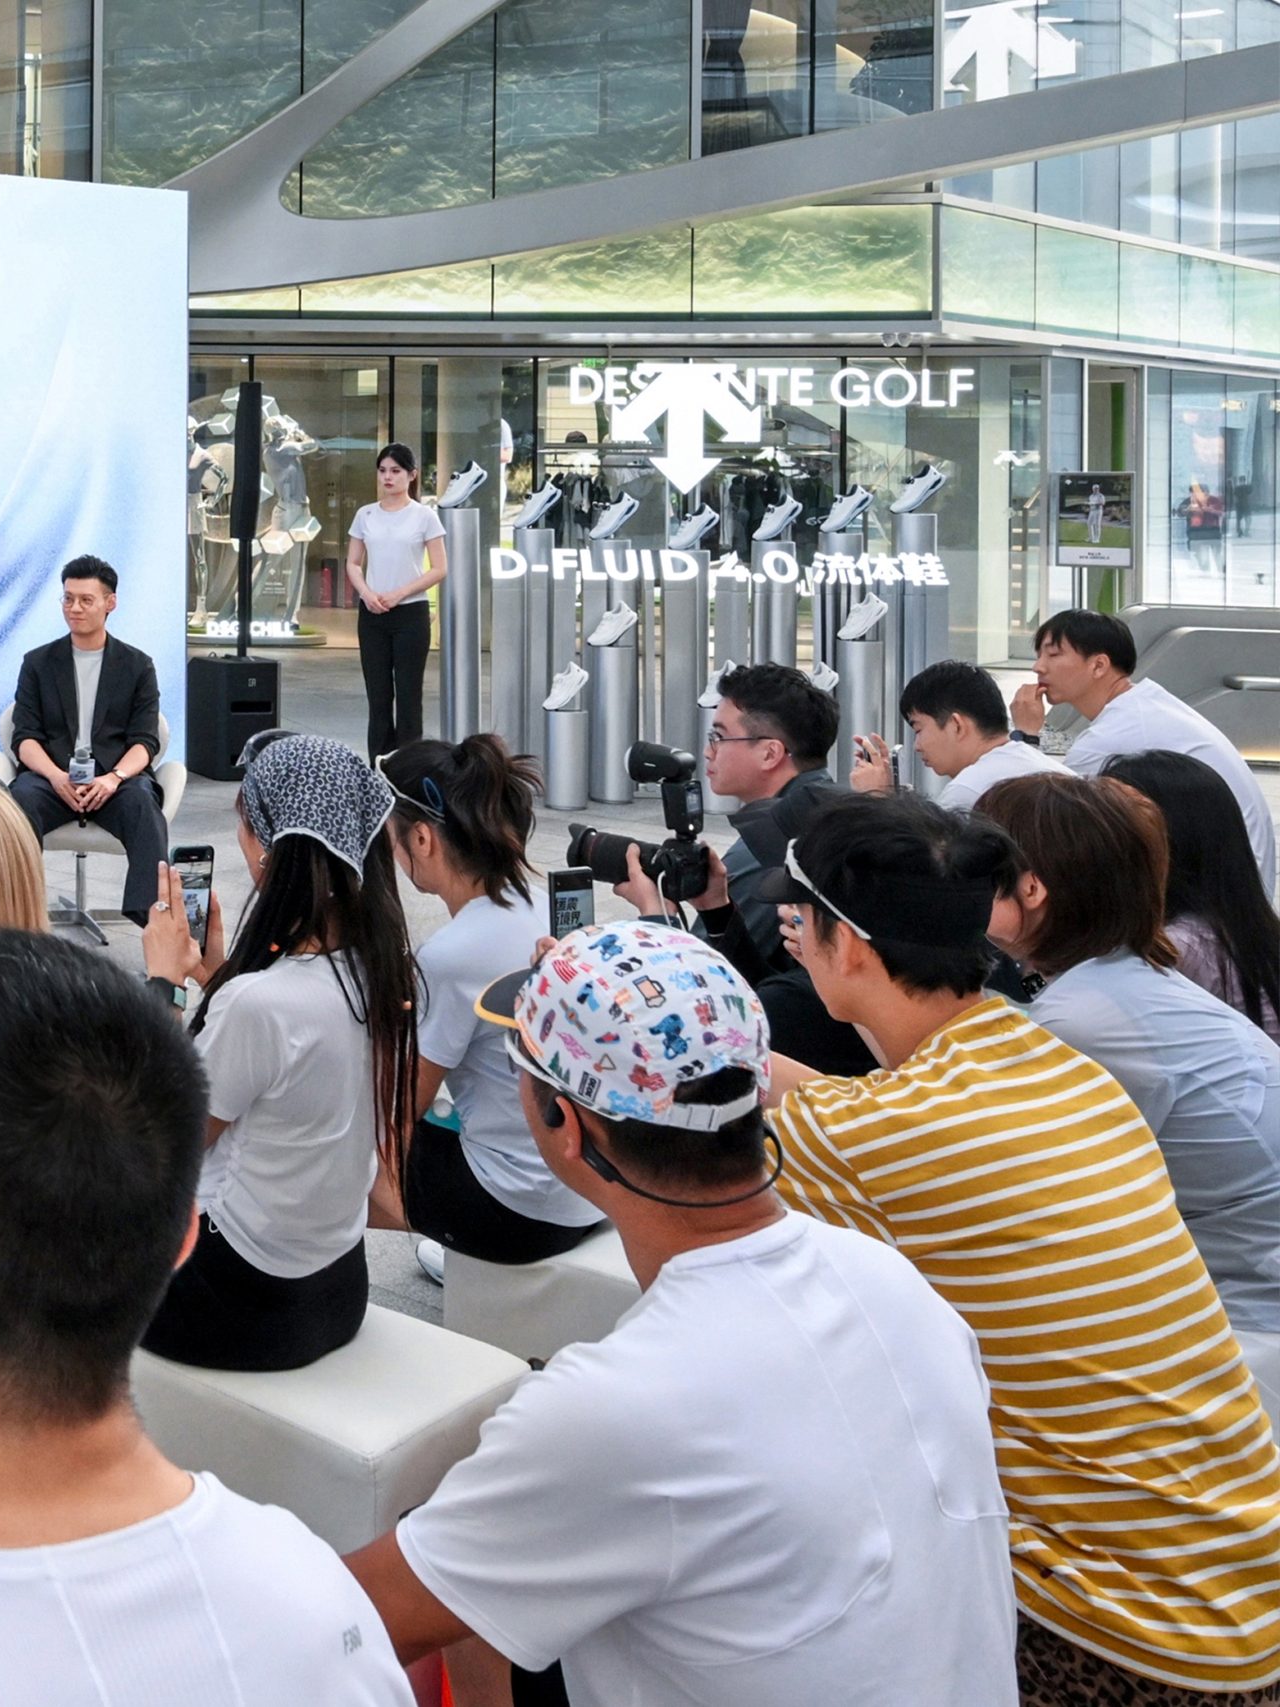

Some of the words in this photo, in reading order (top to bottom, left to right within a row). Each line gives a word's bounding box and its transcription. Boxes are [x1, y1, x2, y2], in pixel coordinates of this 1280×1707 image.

[569, 367, 814, 407] DESNTE
[830, 367, 975, 408] GOLF
[490, 547, 699, 582] D-FLUID
[717, 549, 800, 583] 4.0
[812, 551, 950, 586] 流体鞋
[250, 621, 295, 637] CHILL
